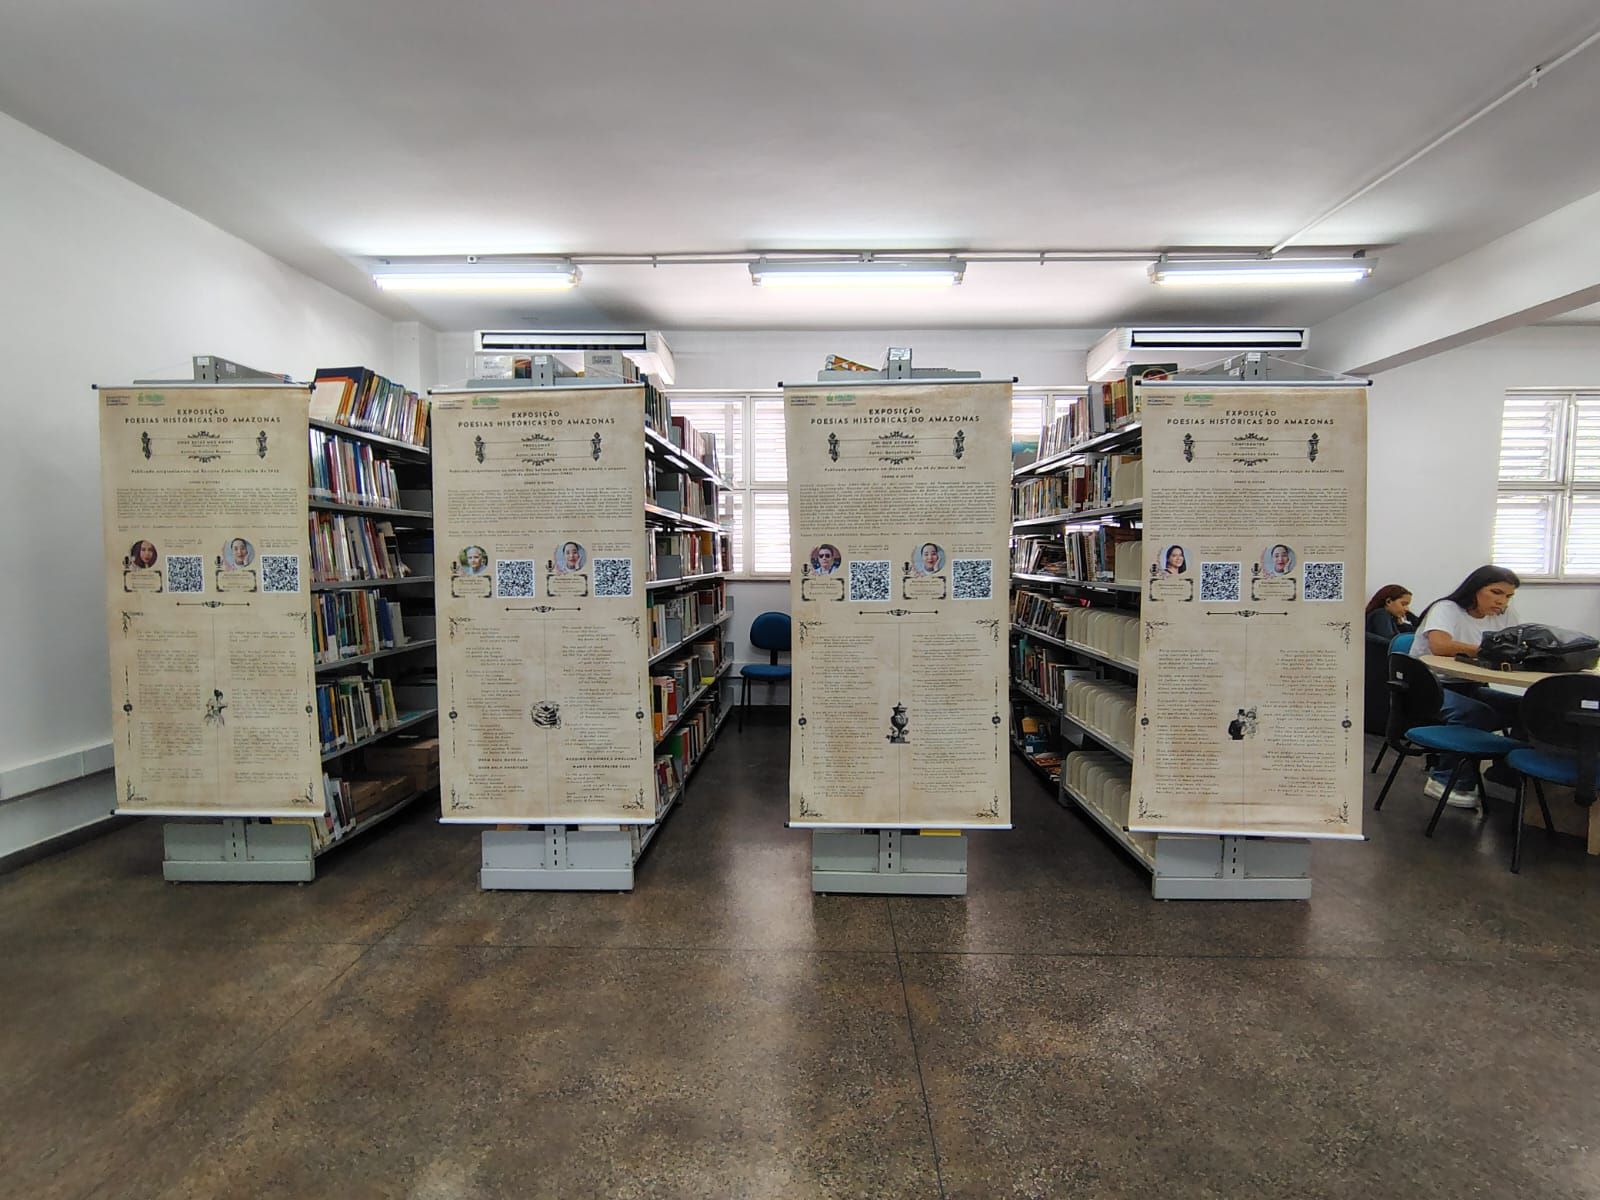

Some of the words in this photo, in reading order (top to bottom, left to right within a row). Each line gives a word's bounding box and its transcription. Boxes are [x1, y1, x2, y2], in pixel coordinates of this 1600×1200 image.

[177, 408, 225, 416] EXPOSIÇÃO
[511, 410, 560, 419] EXPOSIÇÃO
[869, 407, 921, 416] EXPOSIÇÃO
[1226, 408, 1277, 417] EXPOSIÇÃO
[497, 419, 548, 427] HISTÓRICAS
[853, 416, 908, 424] HISTÓRICAS
